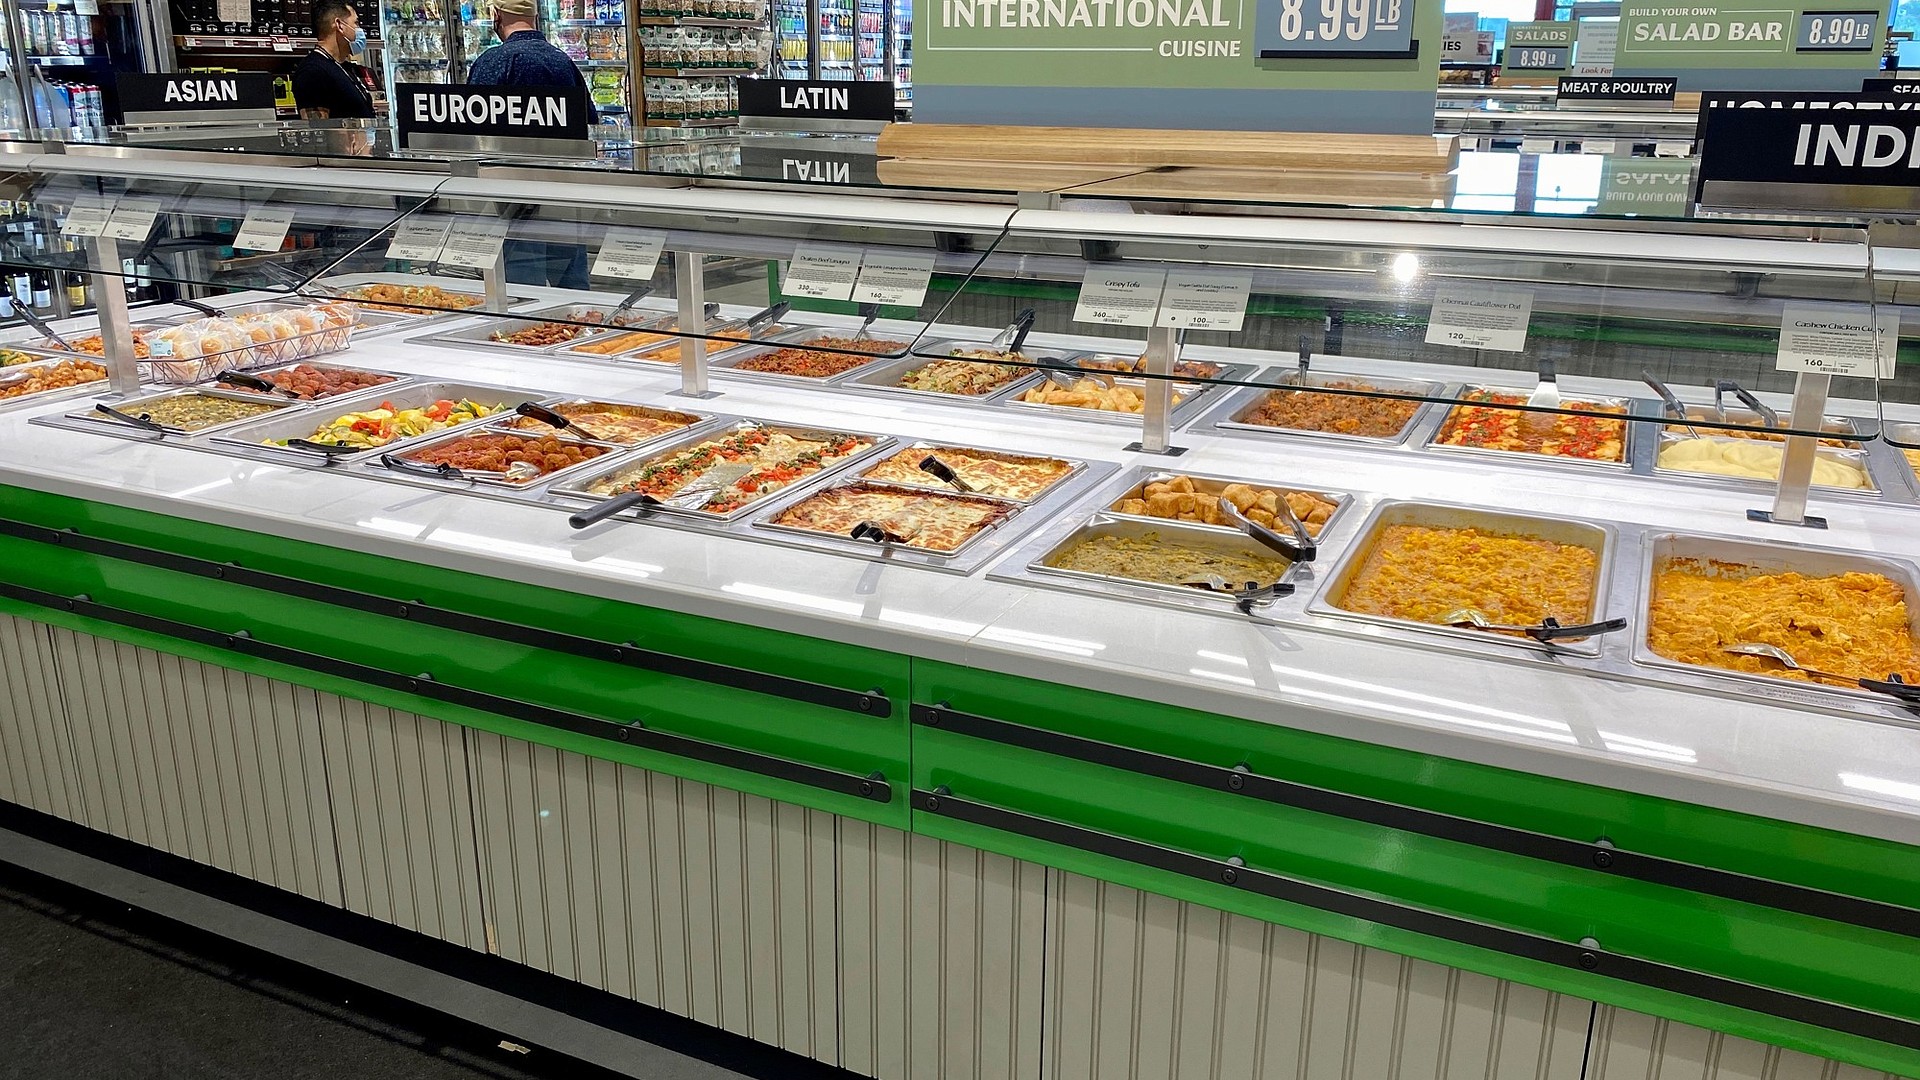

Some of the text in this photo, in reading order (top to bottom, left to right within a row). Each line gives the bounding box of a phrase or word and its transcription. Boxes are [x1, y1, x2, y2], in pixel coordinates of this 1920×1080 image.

[942, 0, 1230, 28] INTERNATIONAL
[1279, 0, 1401, 41] 8.99 LB
[1629, 7, 1717, 17] BUILD YOUR OWN
[1515, 30, 1568, 41] SALADS
[1633, 22, 1721, 42] SALAD
[1728, 22, 1783, 42] BAR
[1808, 18, 1870, 44] 8.99 LB
[1159, 40, 1241, 57] CUISINE
[1520, 50, 1547, 67] 8.99
[1580, 66, 1599, 74] Look
[164, 79, 238, 103] ASIAN
[1561, 82, 1673, 95] MEAT & POULTRY
[780, 86, 849, 111] LATIN
[413, 93, 568, 128] EUROPEAN
[1104, 279, 1127, 289] Crispy
[1794, 320, 1828, 328] Cashew
[1828, 322, 1861, 332] Chicken
[1861, 325, 1885, 334] Cuy
[1448, 332, 1464, 340] 120
[1804, 358, 1823, 367] 160
